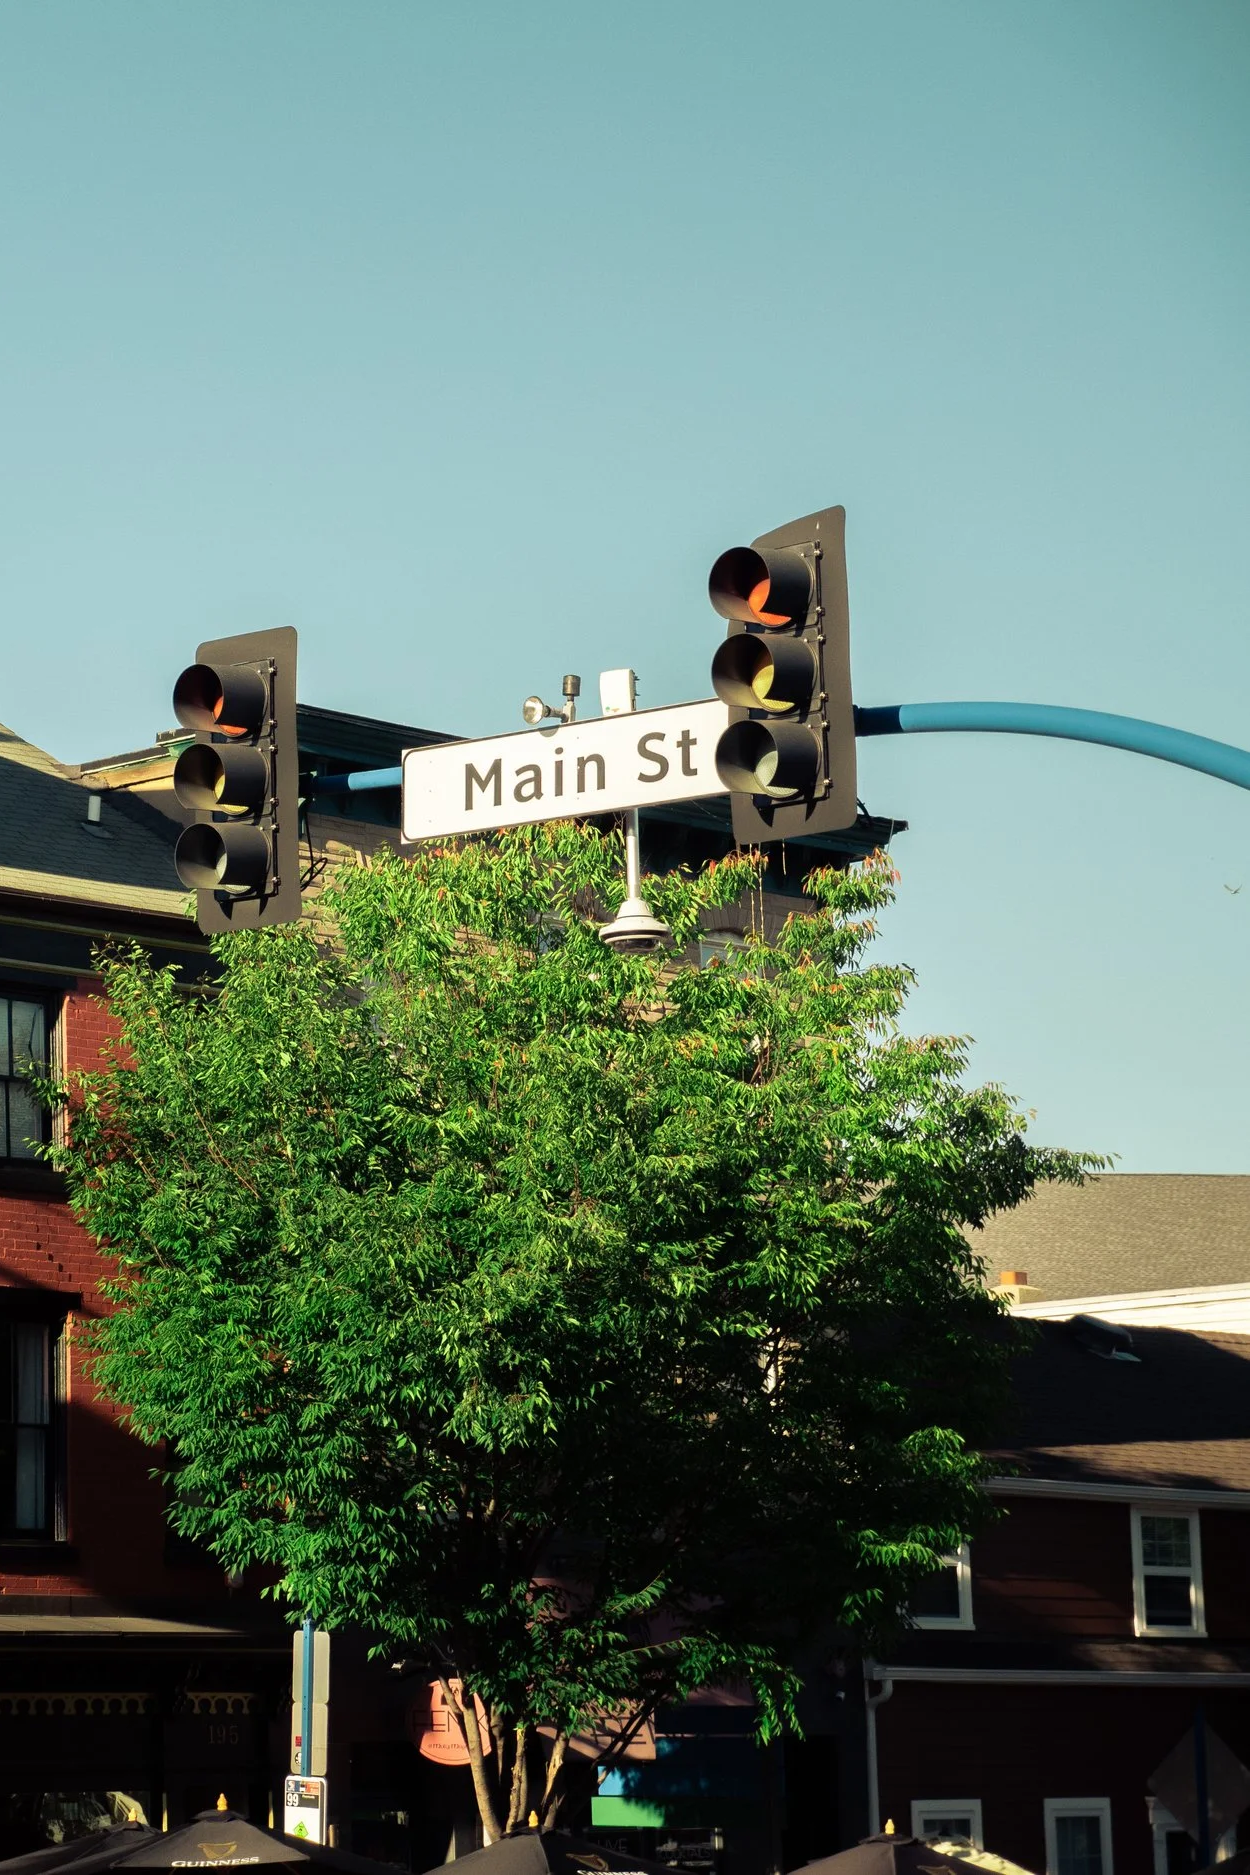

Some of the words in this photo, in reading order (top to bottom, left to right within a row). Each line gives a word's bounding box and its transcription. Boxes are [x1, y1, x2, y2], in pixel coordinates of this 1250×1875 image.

[465, 747, 605, 811] Main
[637, 730, 697, 783] St
[207, 1723, 239, 1745] 195
[287, 1792, 299, 1807] 99
[171, 1857, 260, 1868] GUINNESS
